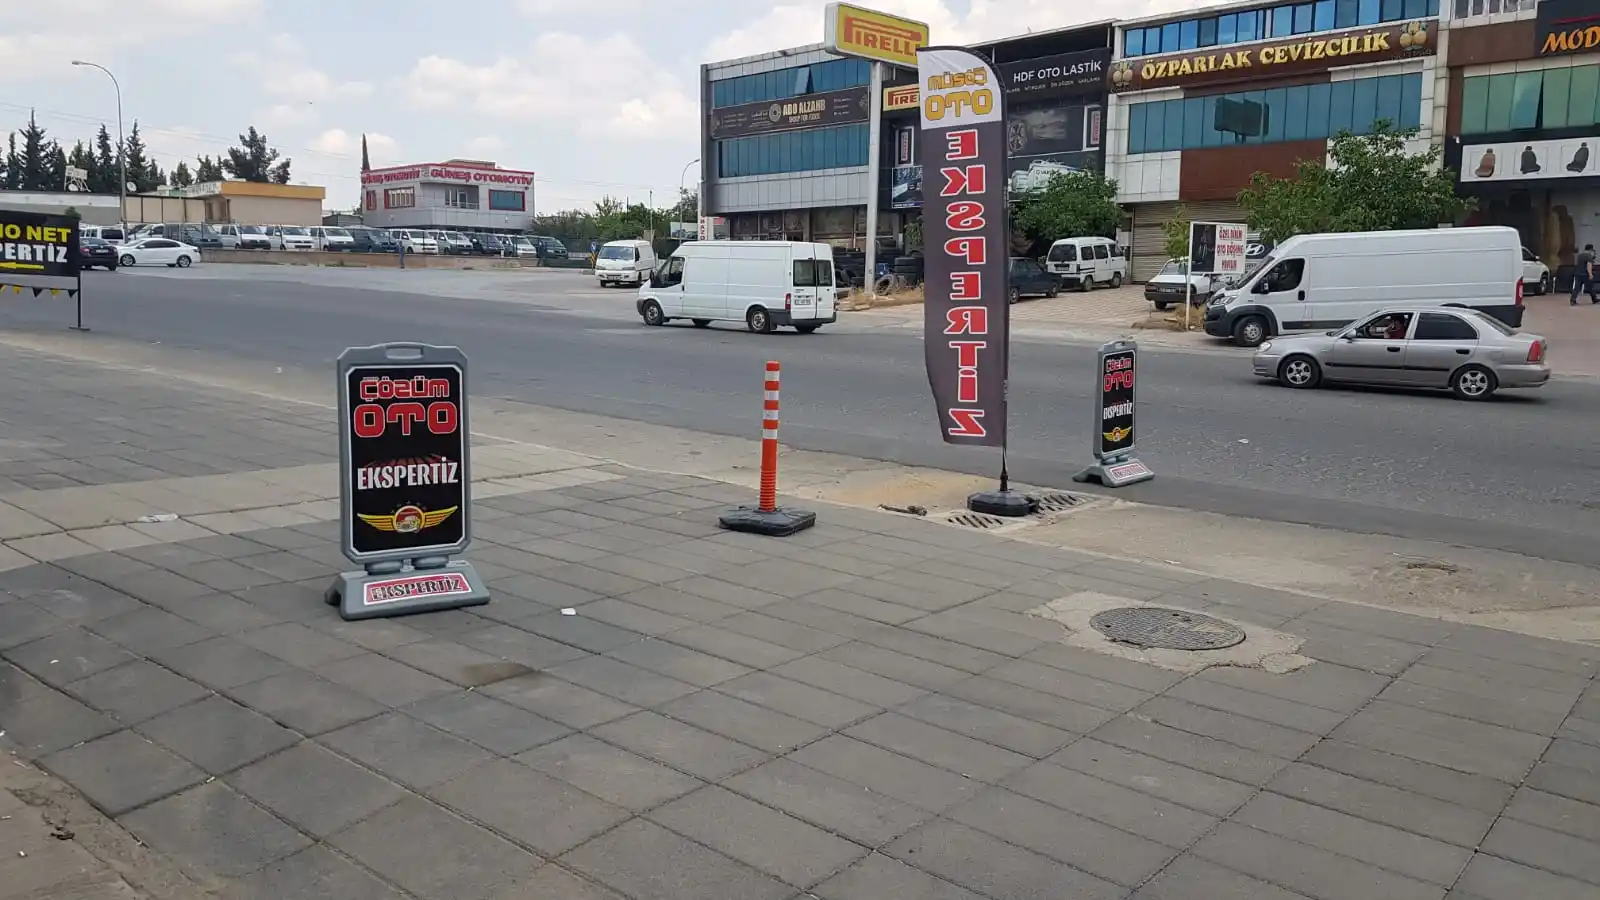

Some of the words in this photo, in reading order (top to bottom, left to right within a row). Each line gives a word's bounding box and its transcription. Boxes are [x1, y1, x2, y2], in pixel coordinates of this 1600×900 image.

[1141, 50, 1253, 80] ÖZPARLAK
[1259, 29, 1392, 65] CEVİZCİLİK
[1013, 70, 1035, 83] HDF
[1037, 67, 1060, 80] OTO
[1063, 59, 1102, 76] LASTİK
[888, 88, 919, 106] PIRE
[431, 167, 471, 183] GÜNEŞ
[473, 173, 534, 186] OTOMOTİV
[26, 225, 71, 243] NET
[360, 376, 450, 402] ÇÖZÜM
[1103, 370, 1133, 392] OTO
[353, 401, 458, 438] OTO
[357, 456, 459, 490] EKSPERTİZ
[371, 575, 462, 601] EKSPERTİZ
